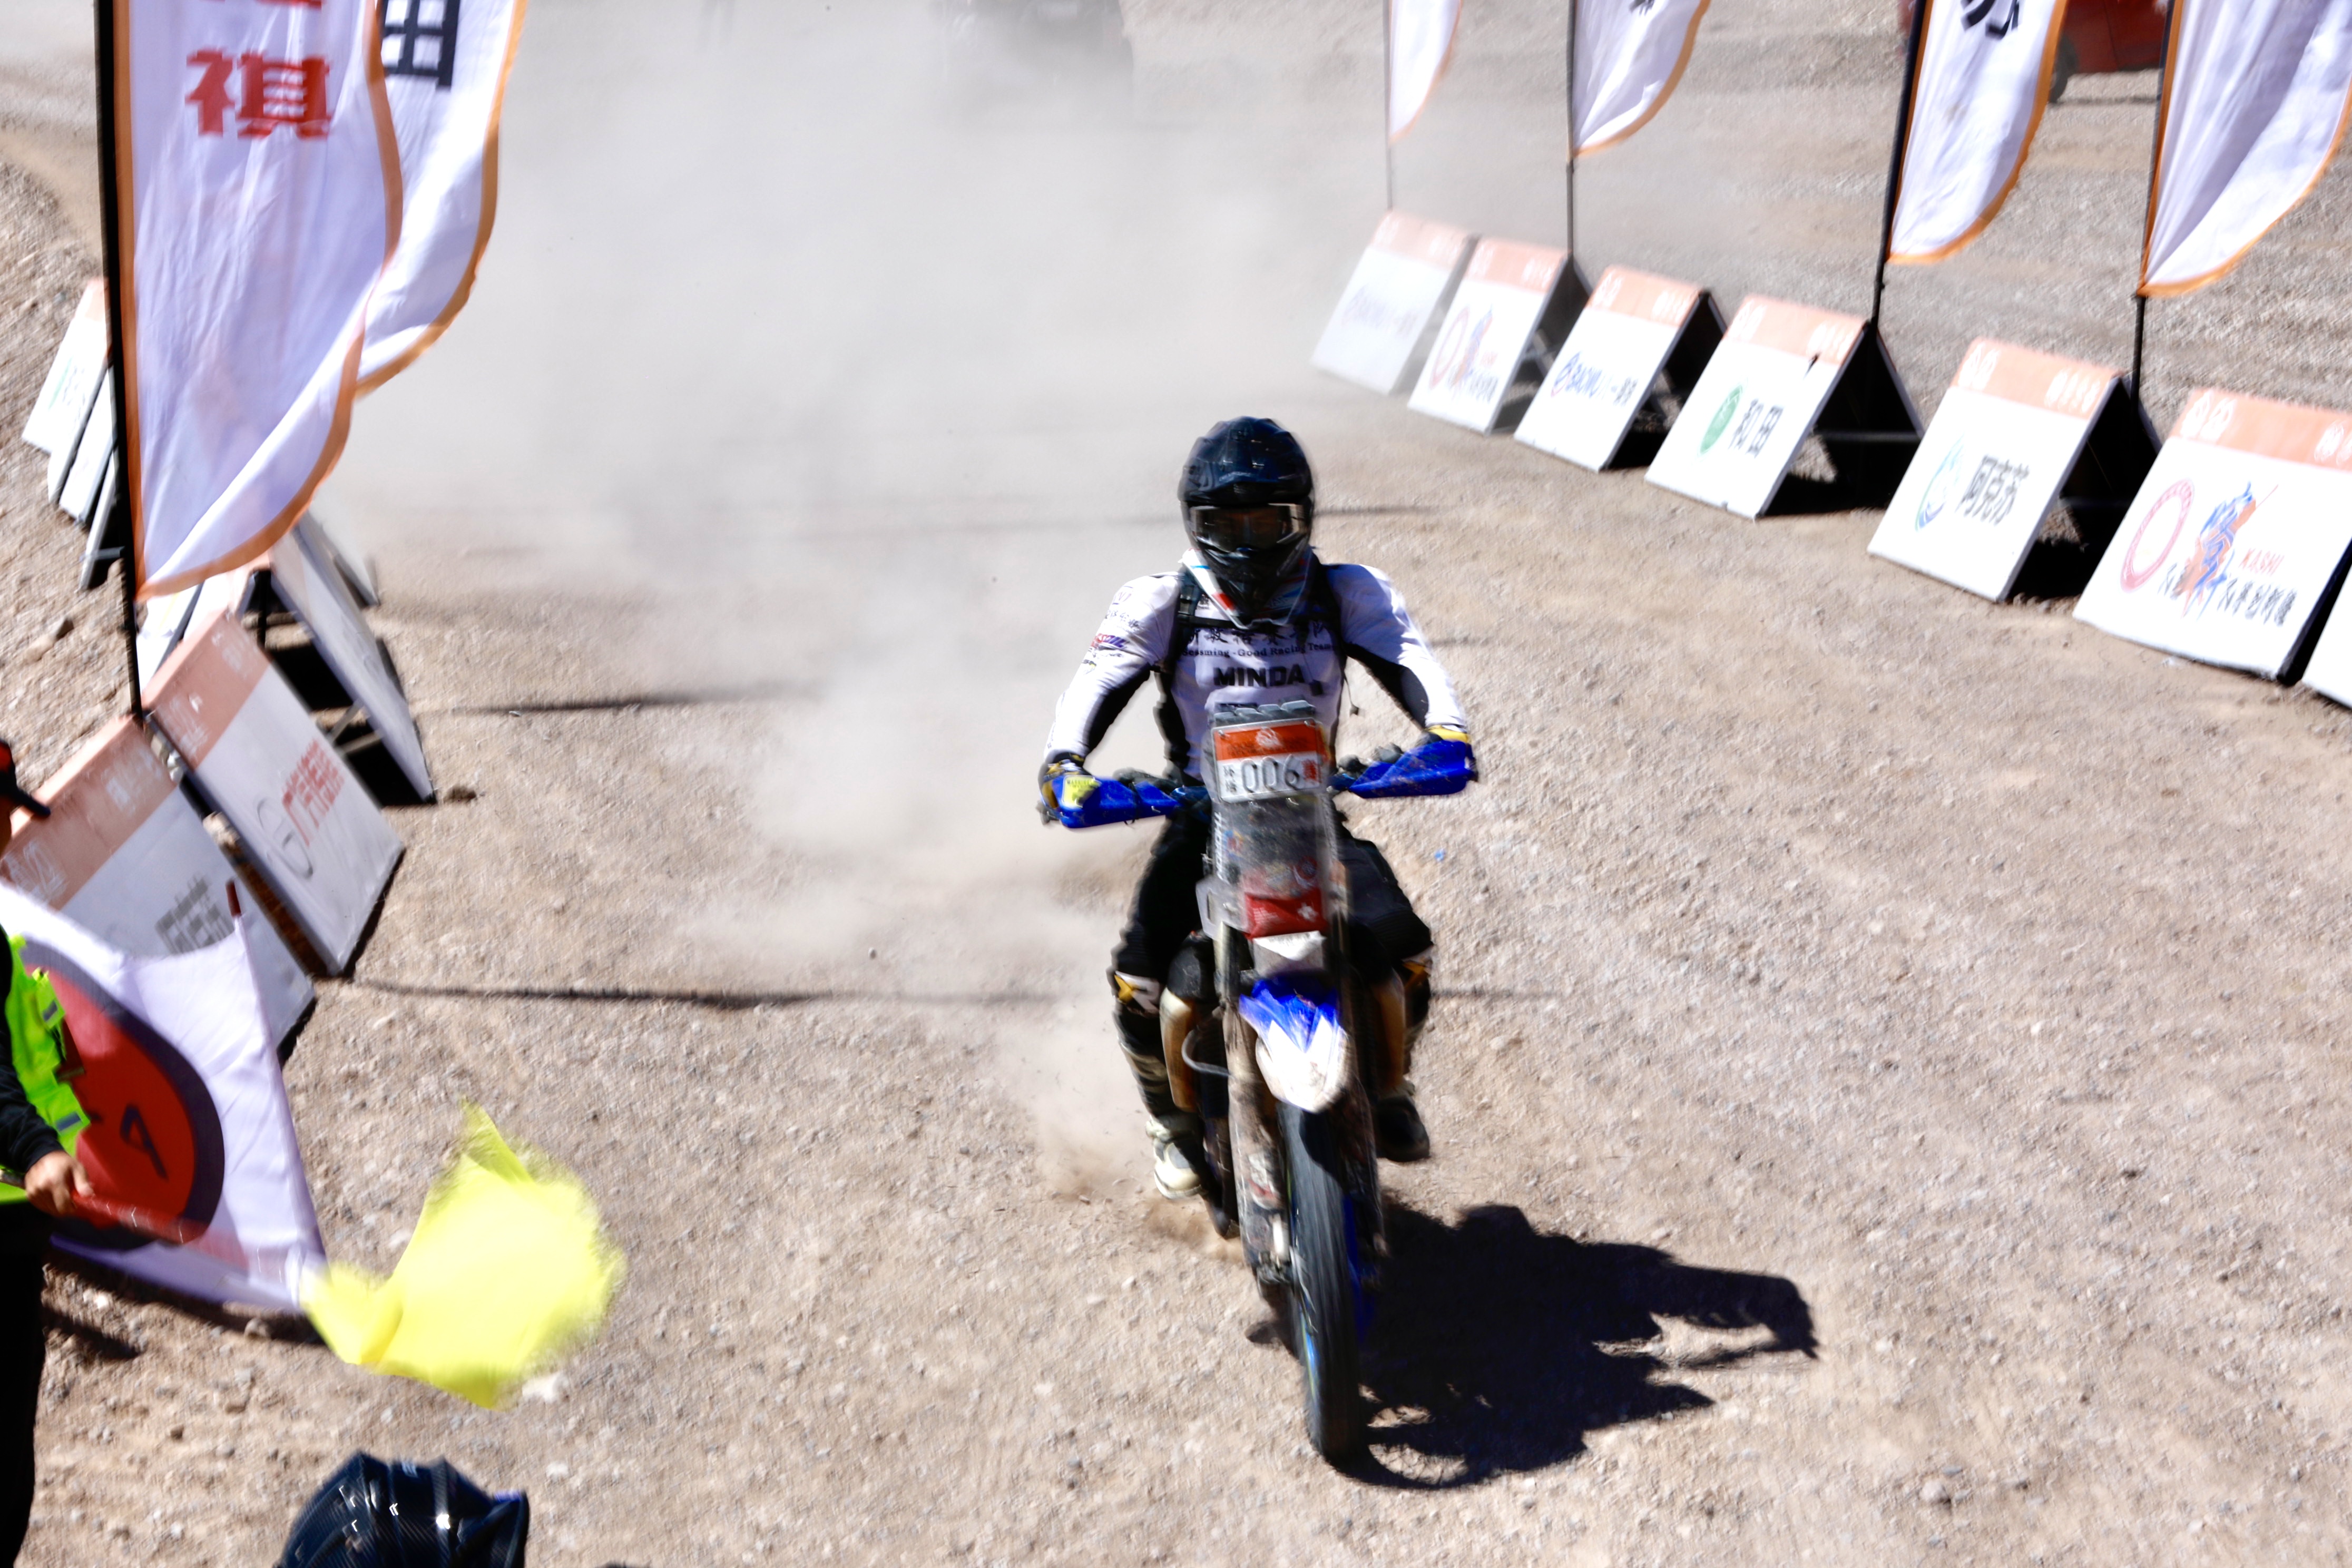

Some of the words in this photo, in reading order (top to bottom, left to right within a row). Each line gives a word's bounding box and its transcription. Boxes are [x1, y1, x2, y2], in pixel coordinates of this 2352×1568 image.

[1730, 399, 1783, 456] 和田
[1956, 453, 2030, 525] 阿克苏
[2239, 548, 2285, 576] KASHI
[1270, 644, 1306, 655] Racing
[1213, 664, 1306, 688] MINDA
[1241, 754, 1300, 793] 006
